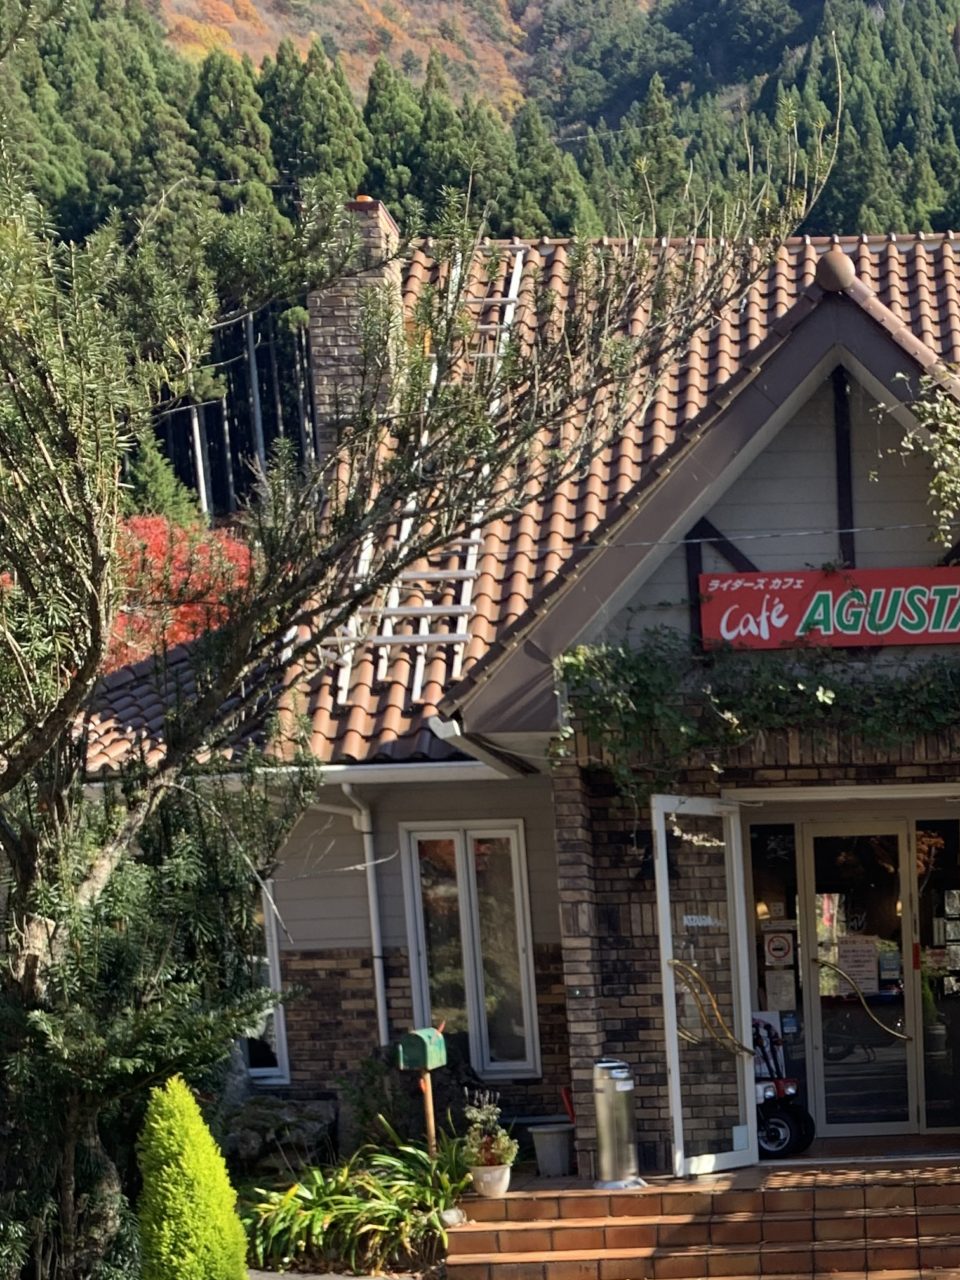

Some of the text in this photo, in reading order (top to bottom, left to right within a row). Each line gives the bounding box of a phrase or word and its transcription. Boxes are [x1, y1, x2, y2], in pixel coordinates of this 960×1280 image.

[708, 577, 805, 592] ライダーズ カフェ
[720, 594, 790, 641] Café
